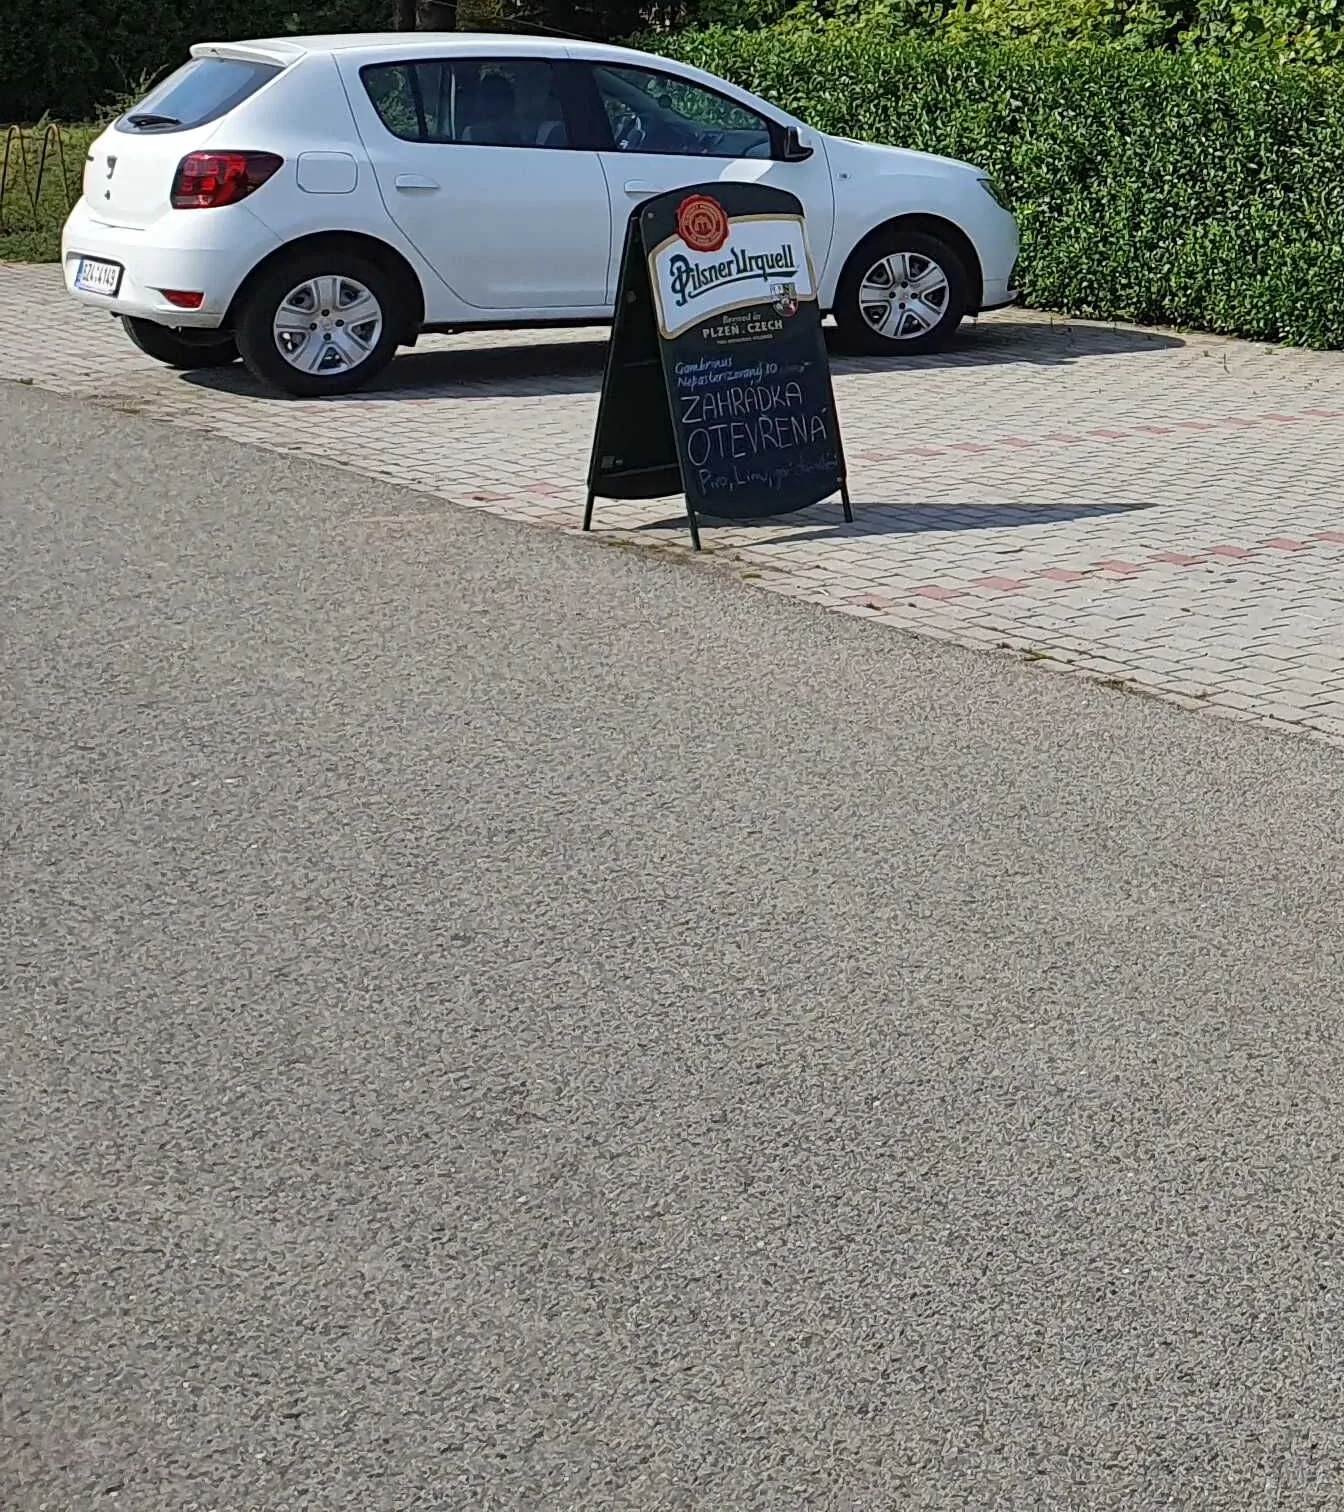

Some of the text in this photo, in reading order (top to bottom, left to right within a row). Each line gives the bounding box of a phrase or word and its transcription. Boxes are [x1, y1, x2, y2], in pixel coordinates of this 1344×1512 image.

[669, 244, 796, 307] Pilsner Urquell
[679, 380, 804, 424] ZAHRÁDKA
[687, 407, 829, 466] OTEVŘENÁ
